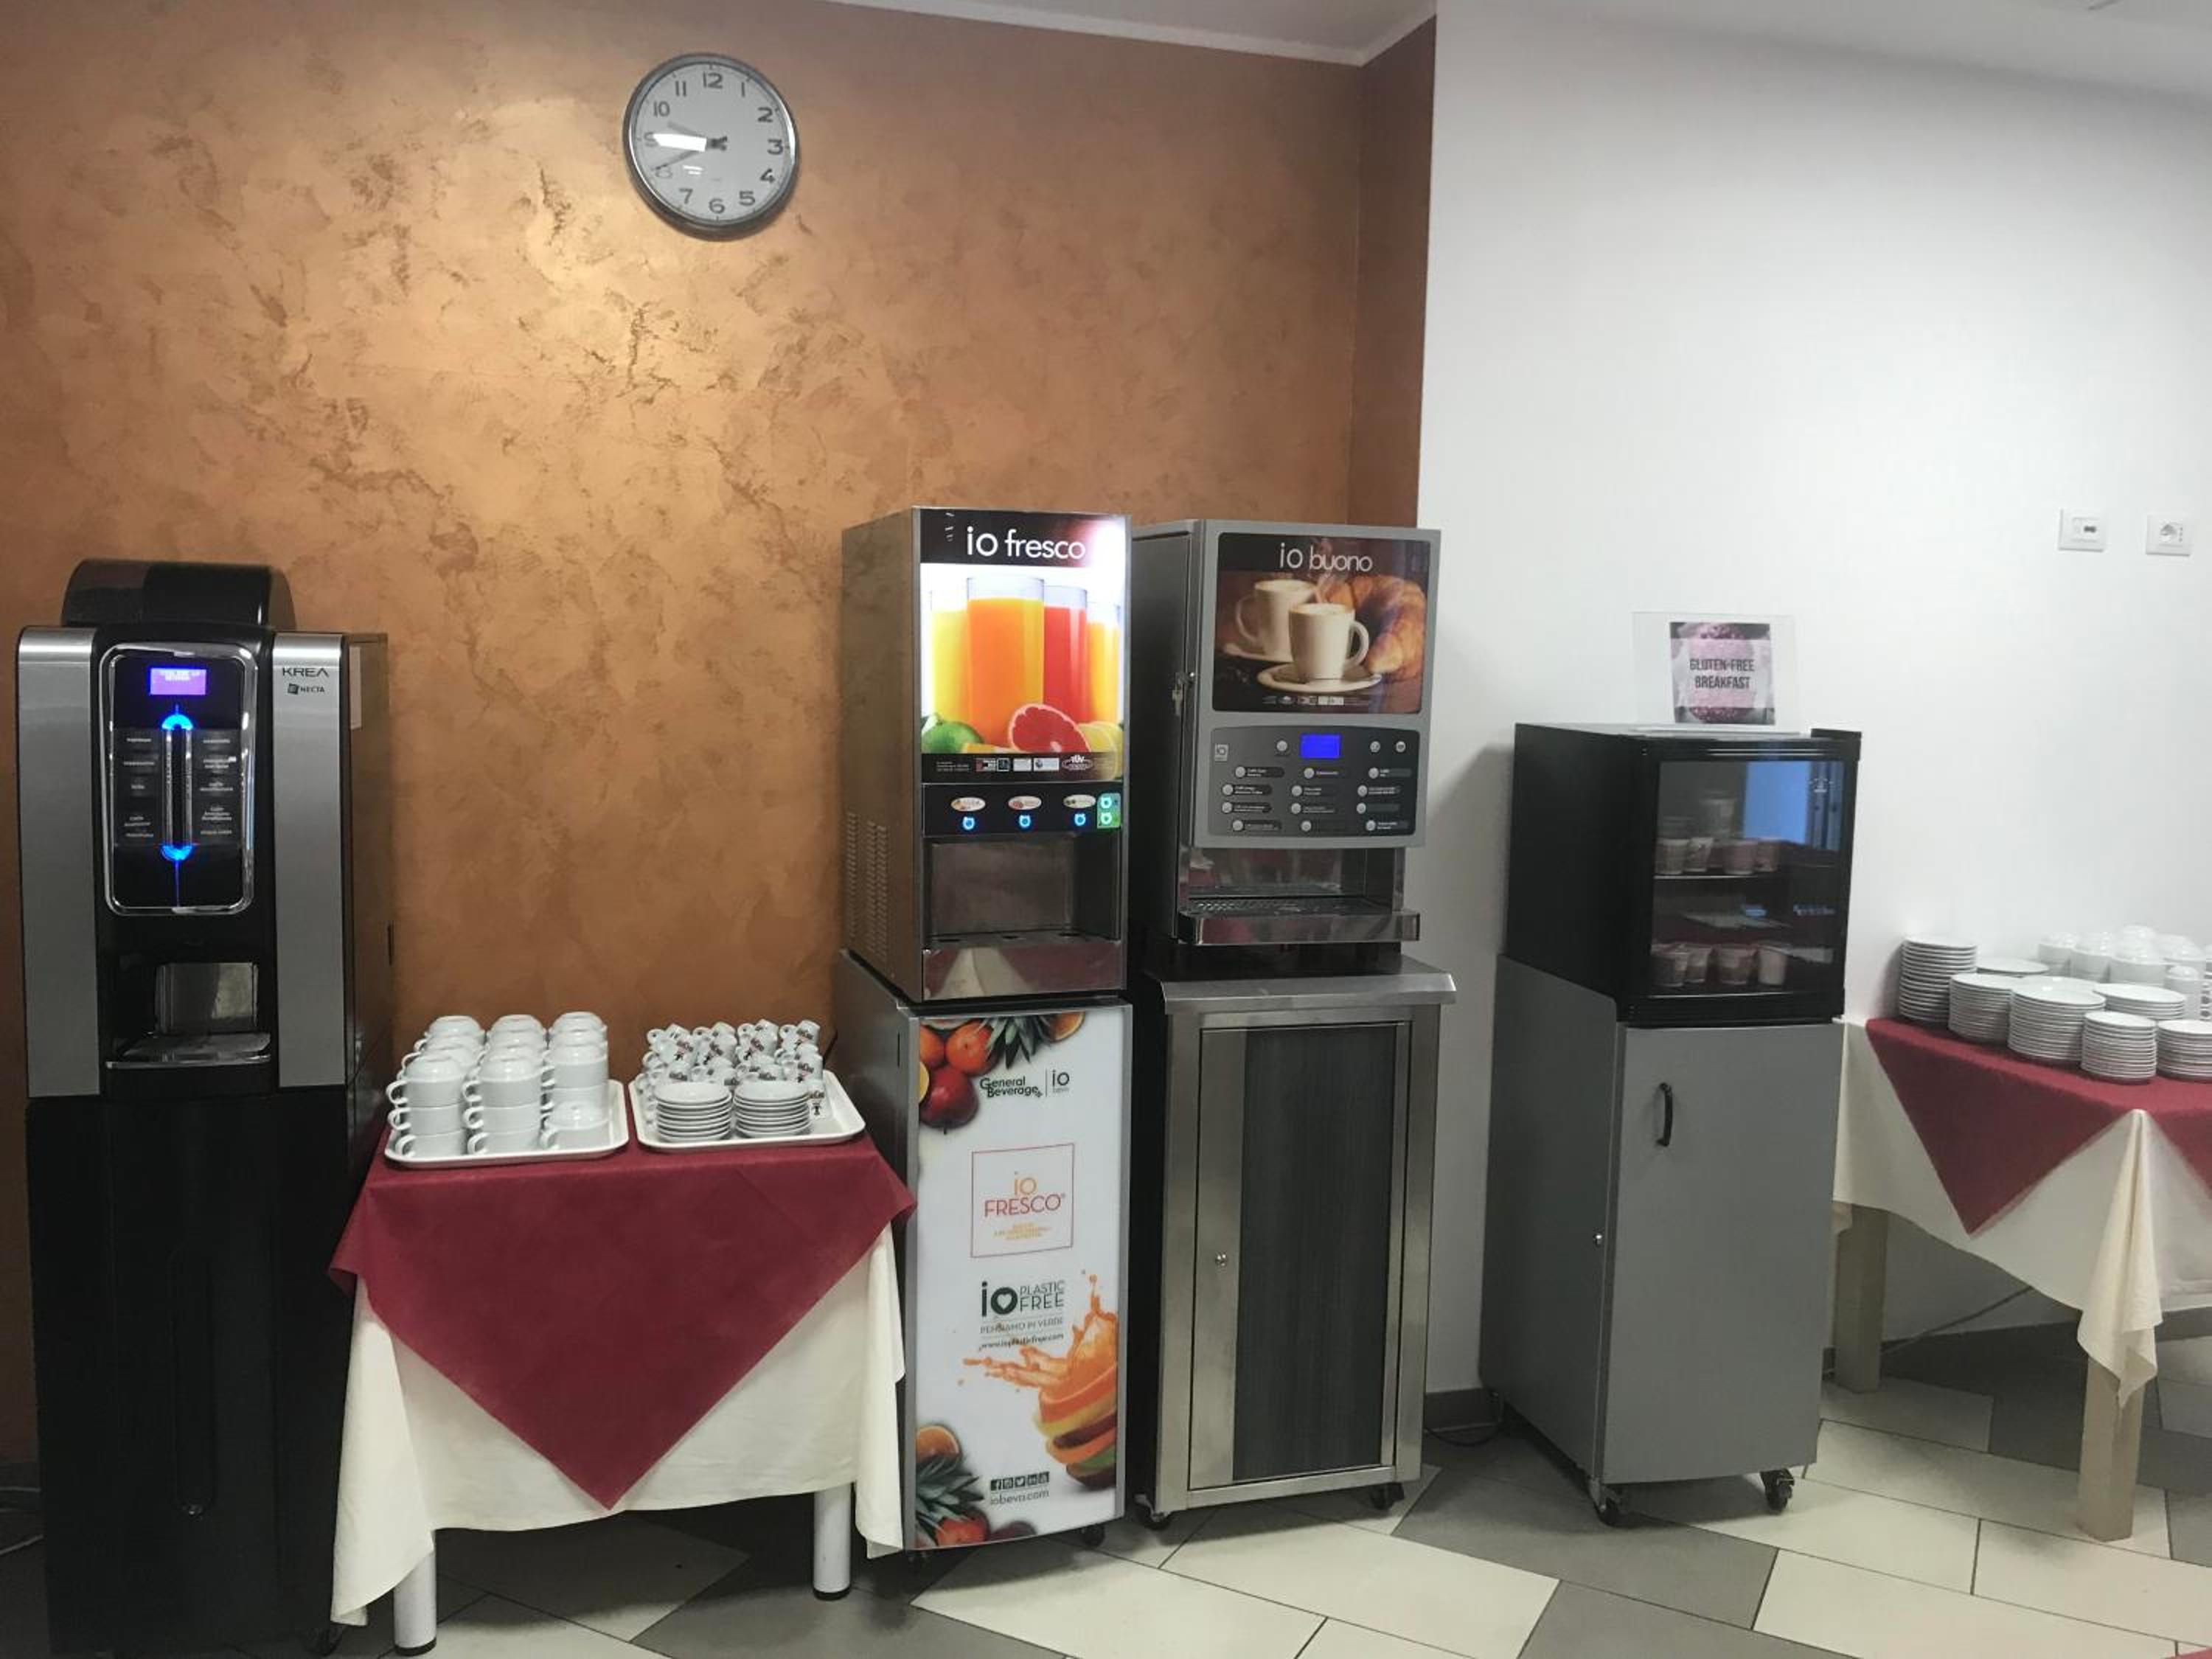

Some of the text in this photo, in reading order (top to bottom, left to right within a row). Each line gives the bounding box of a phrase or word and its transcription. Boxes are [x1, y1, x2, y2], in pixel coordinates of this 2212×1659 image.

[703, 71, 723, 88] 12
[675, 80, 687, 97] 11
[741, 82, 745, 97] 1
[653, 101, 670, 117] 10
[757, 107, 773, 122] 2
[768, 139, 784, 155] 3
[759, 168, 776, 184] 4
[679, 188, 693, 204] 7
[739, 190, 756, 206] 5
[709, 198, 726, 215] 6
[967, 526, 1086, 559] io fresco
[1280, 542, 1373, 571] io buono
[282, 667, 330, 678] KREA
[1689, 658, 1755, 672] GLUTEN-FREE
[1694, 675, 1750, 689] BREAKFAST
[979, 1069, 1070, 1090] General io
[987, 1086, 1039, 1098] Beverage
[1014, 1171, 1037, 1196] io
[1020, 1280, 1065, 1296] PLASTIC
[1020, 1292, 1065, 1312] FREE
